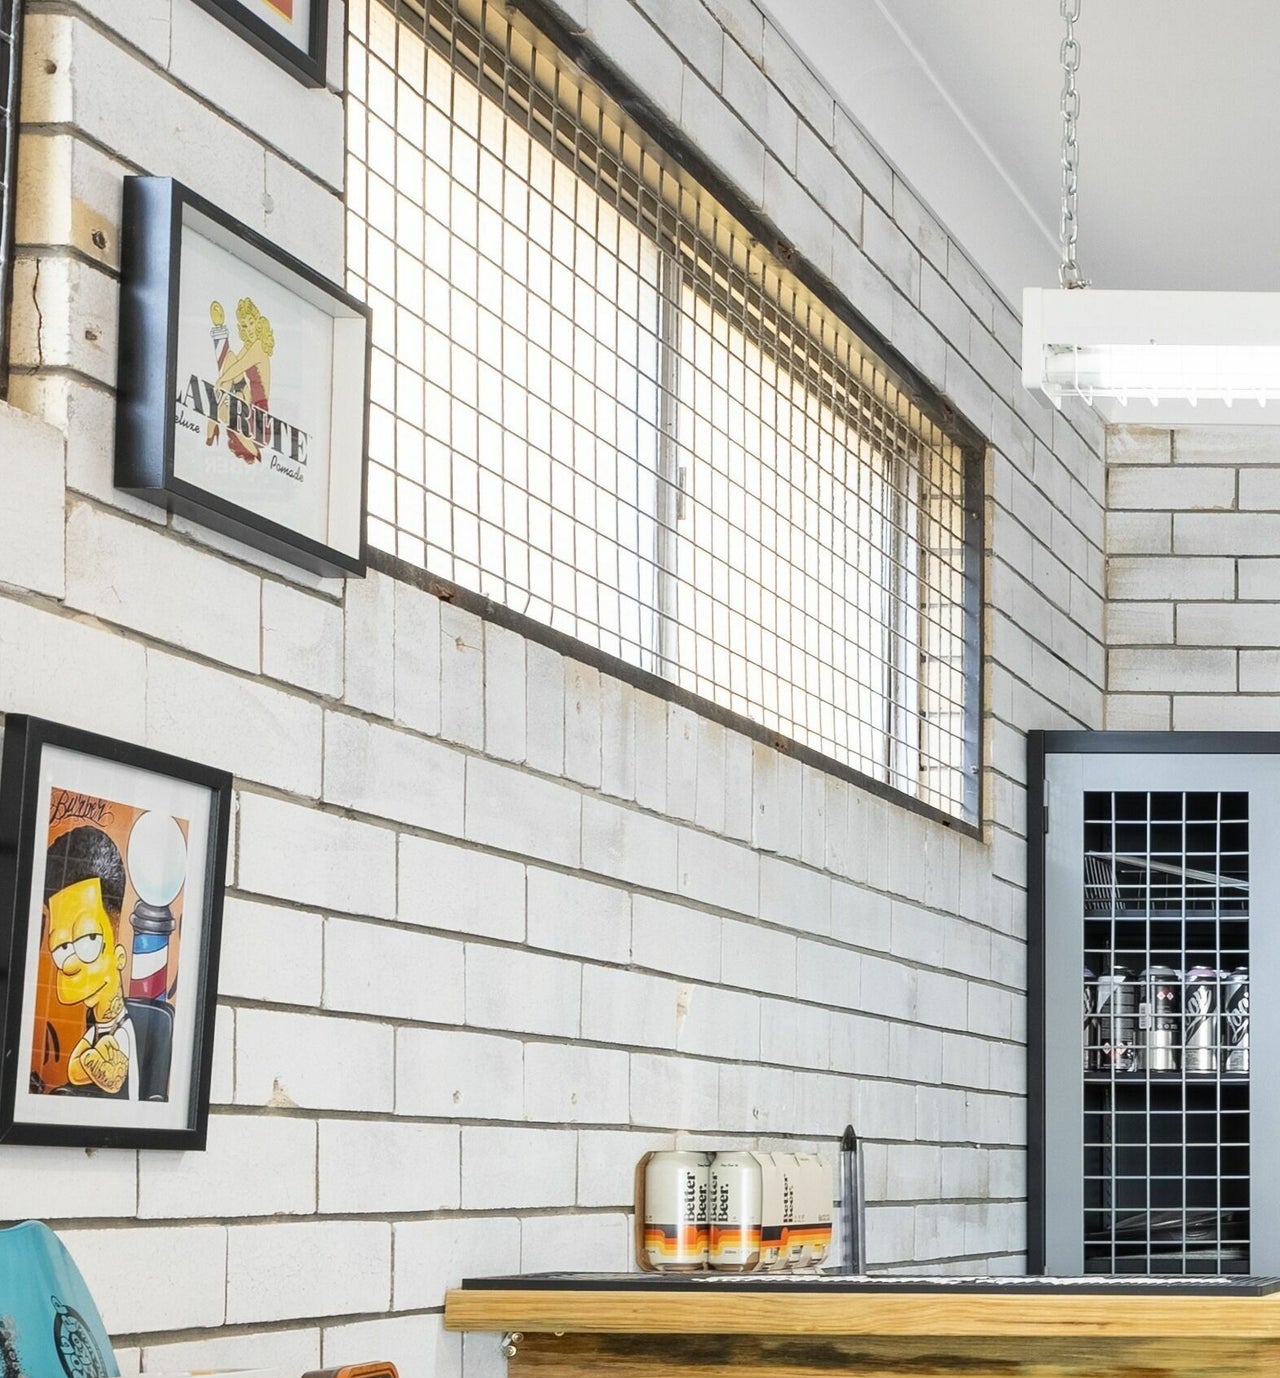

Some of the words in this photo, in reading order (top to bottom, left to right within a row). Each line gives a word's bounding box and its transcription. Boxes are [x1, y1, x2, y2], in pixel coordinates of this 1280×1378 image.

[270, 455, 304, 483] Pomade
[684, 1172, 696, 1222] Better
[718, 1183, 729, 1222] Beer.
